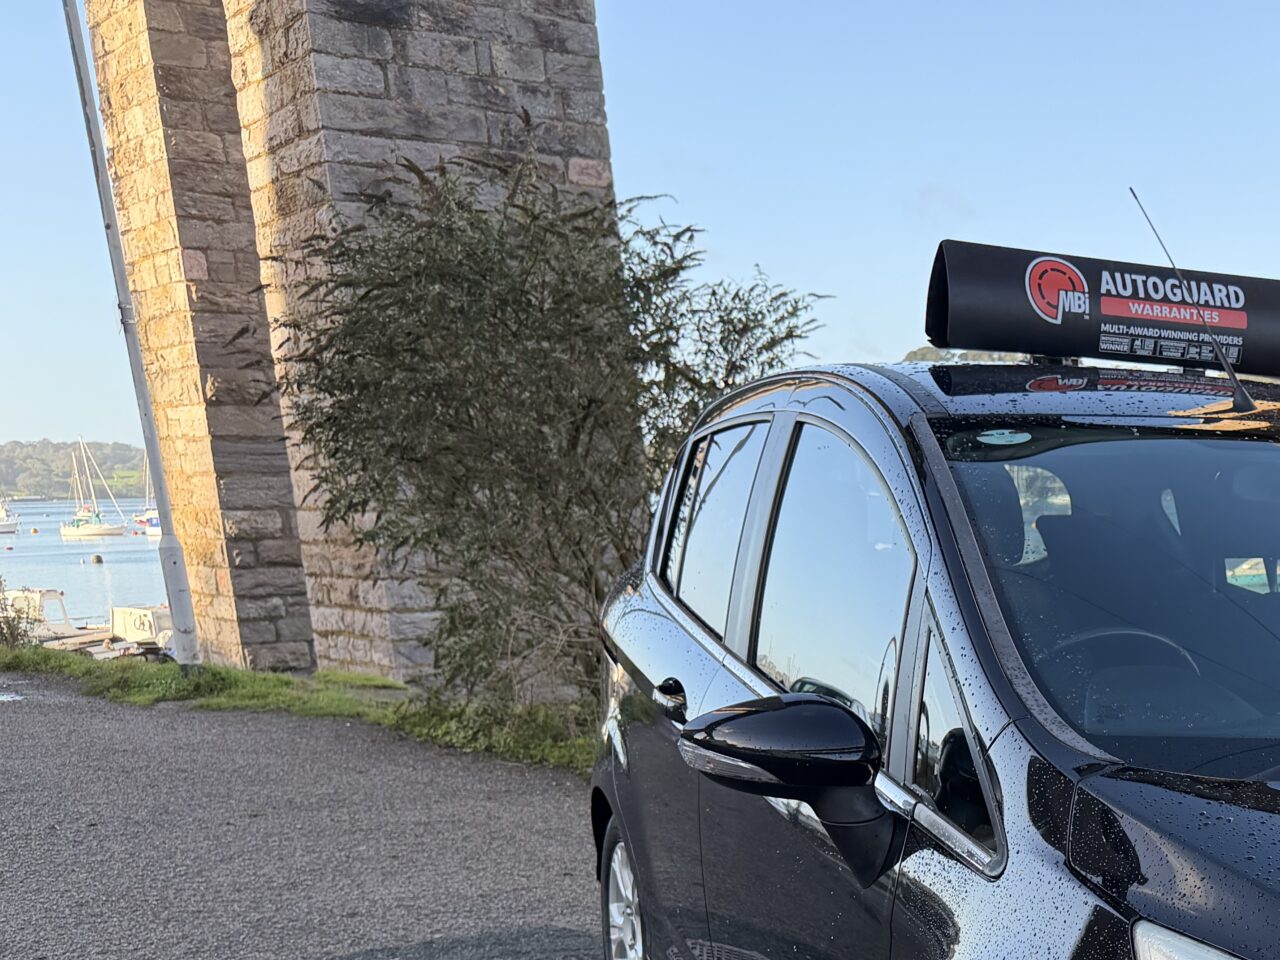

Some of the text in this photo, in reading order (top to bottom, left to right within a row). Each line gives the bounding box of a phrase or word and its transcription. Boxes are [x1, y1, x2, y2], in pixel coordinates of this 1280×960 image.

[1100, 270, 1246, 309] AUTOGUARD
[1100, 323, 1160, 338] MULTI-AWARD
[1160, 329, 1198, 341] WINNING
